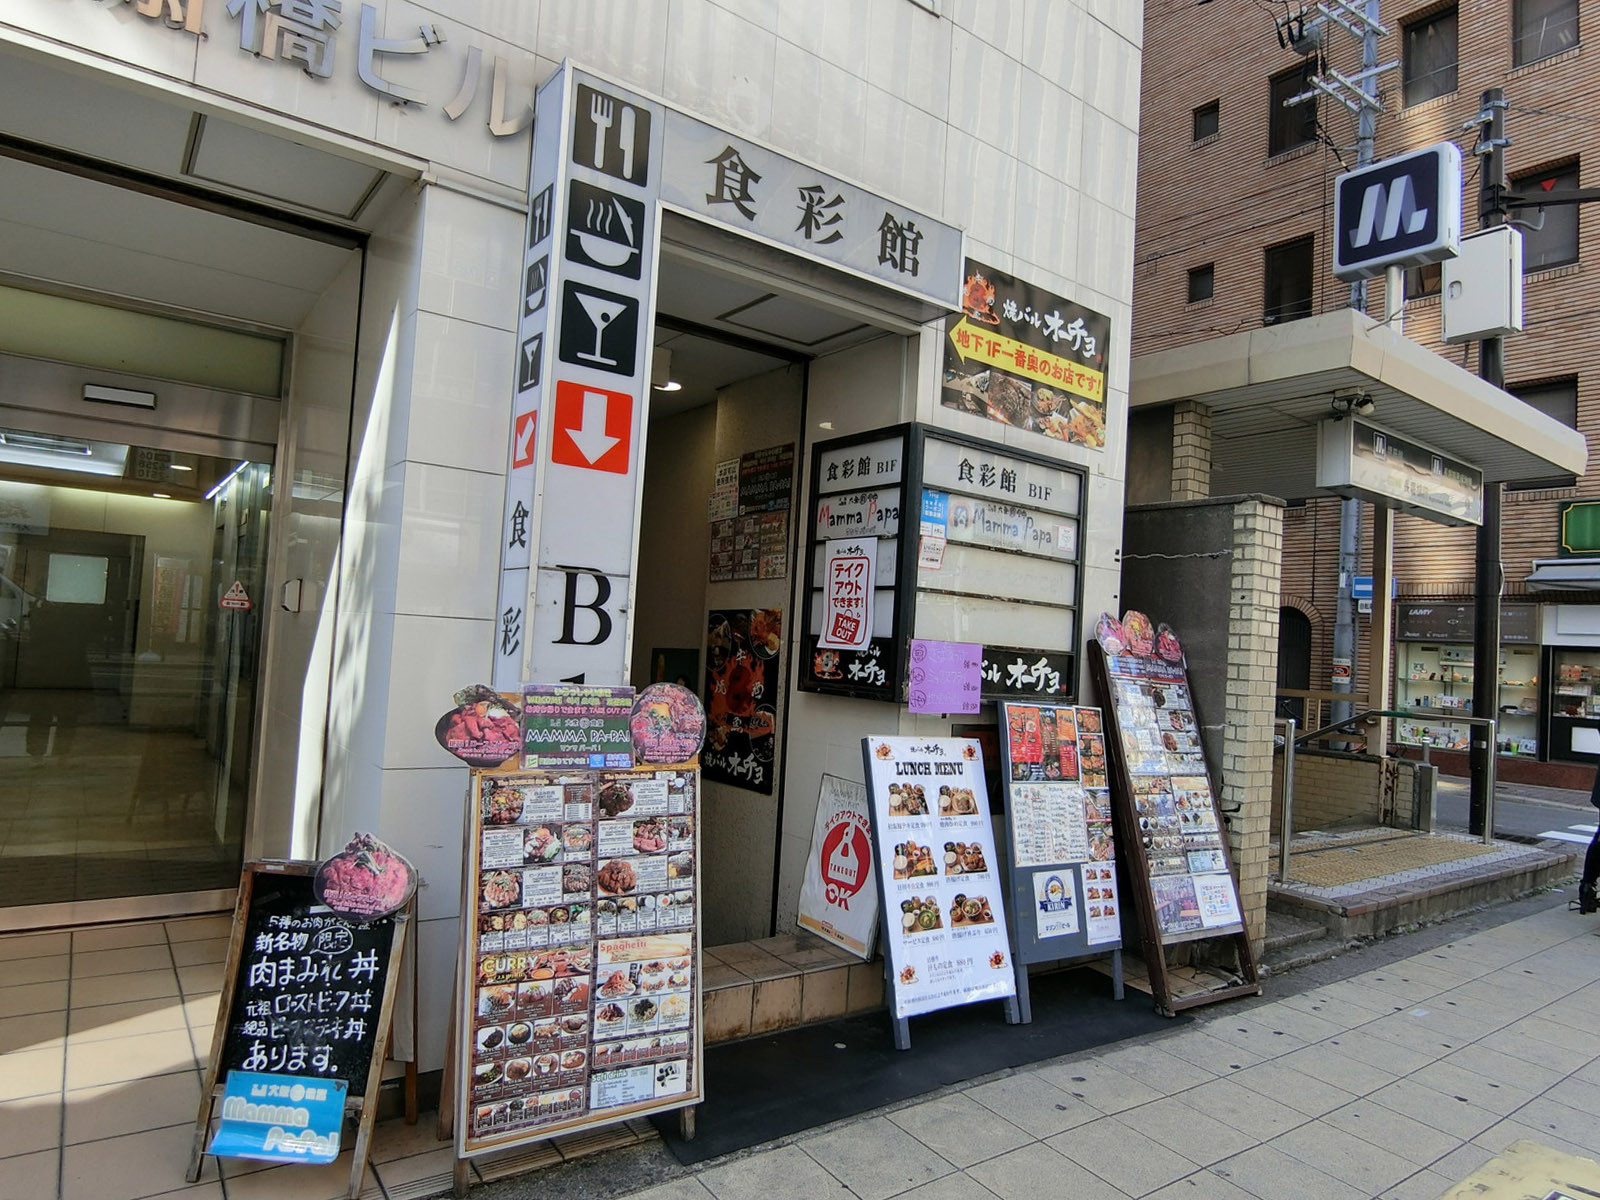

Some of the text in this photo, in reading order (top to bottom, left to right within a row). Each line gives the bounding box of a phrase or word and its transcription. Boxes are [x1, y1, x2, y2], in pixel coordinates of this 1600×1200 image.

[704, 144, 925, 278] 食彩館
[826, 455, 898, 482] 食彩館 B1F
[957, 457, 1053, 501] 食彩館 B1F
[818, 504, 863, 529] Mamma
[866, 499, 900, 529] Papa
[972, 507, 1019, 536] Mamma
[834, 562, 865, 578] テイク
[834, 580, 863, 596] アウト
[832, 596, 864, 609] できます!
[837, 617, 857, 632] TAKE
[835, 629, 853, 643] OUT
[525, 729, 588, 743] MAMMA
[895, 761, 964, 776] LUNCH MENU
[829, 862, 857, 878] TAKEOUT
[824, 882, 853, 912] OK
[256, 931, 310, 954] 新名物
[317, 930, 349, 950] 限定
[600, 941, 647, 952] Spaghetti
[482, 956, 538, 974] CURRY
[242, 1040, 339, 1072] あります。
[222, 1096, 310, 1128] Mamma
